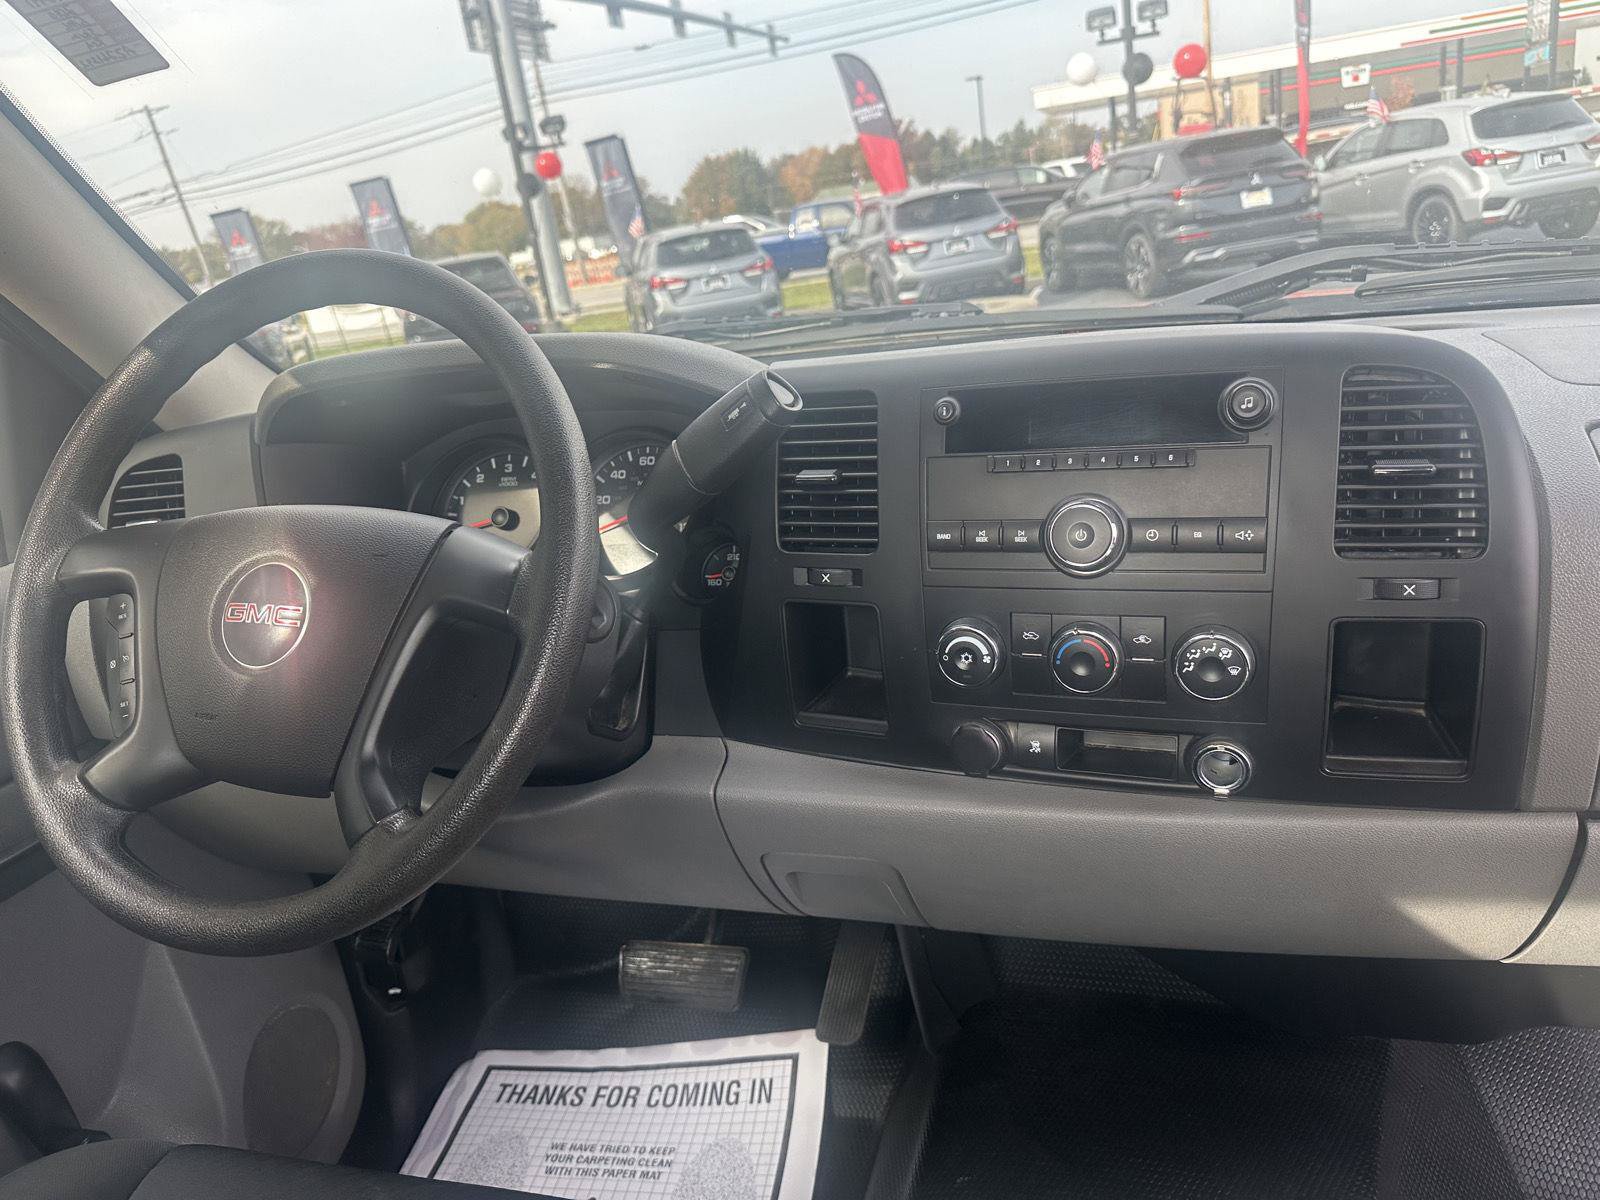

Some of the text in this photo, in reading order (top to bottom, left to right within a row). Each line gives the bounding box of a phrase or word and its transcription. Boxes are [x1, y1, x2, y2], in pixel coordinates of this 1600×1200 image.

[639, 456, 656, 466] 60
[504, 463, 513, 473] 3
[610, 469, 627, 479] 40
[476, 473, 485, 483] 2
[459, 496, 464, 505] 1
[225, 602, 303, 627] GMC
[495, 1077, 773, 1108] THANKS FOR COMING IN
[550, 1142, 676, 1156] WE HAVE TRIED TO KEEP
[544, 1153, 673, 1168] YOUR CARPETING CLEAN
[544, 1166, 663, 1181] WITH THIS PAPER MAT
